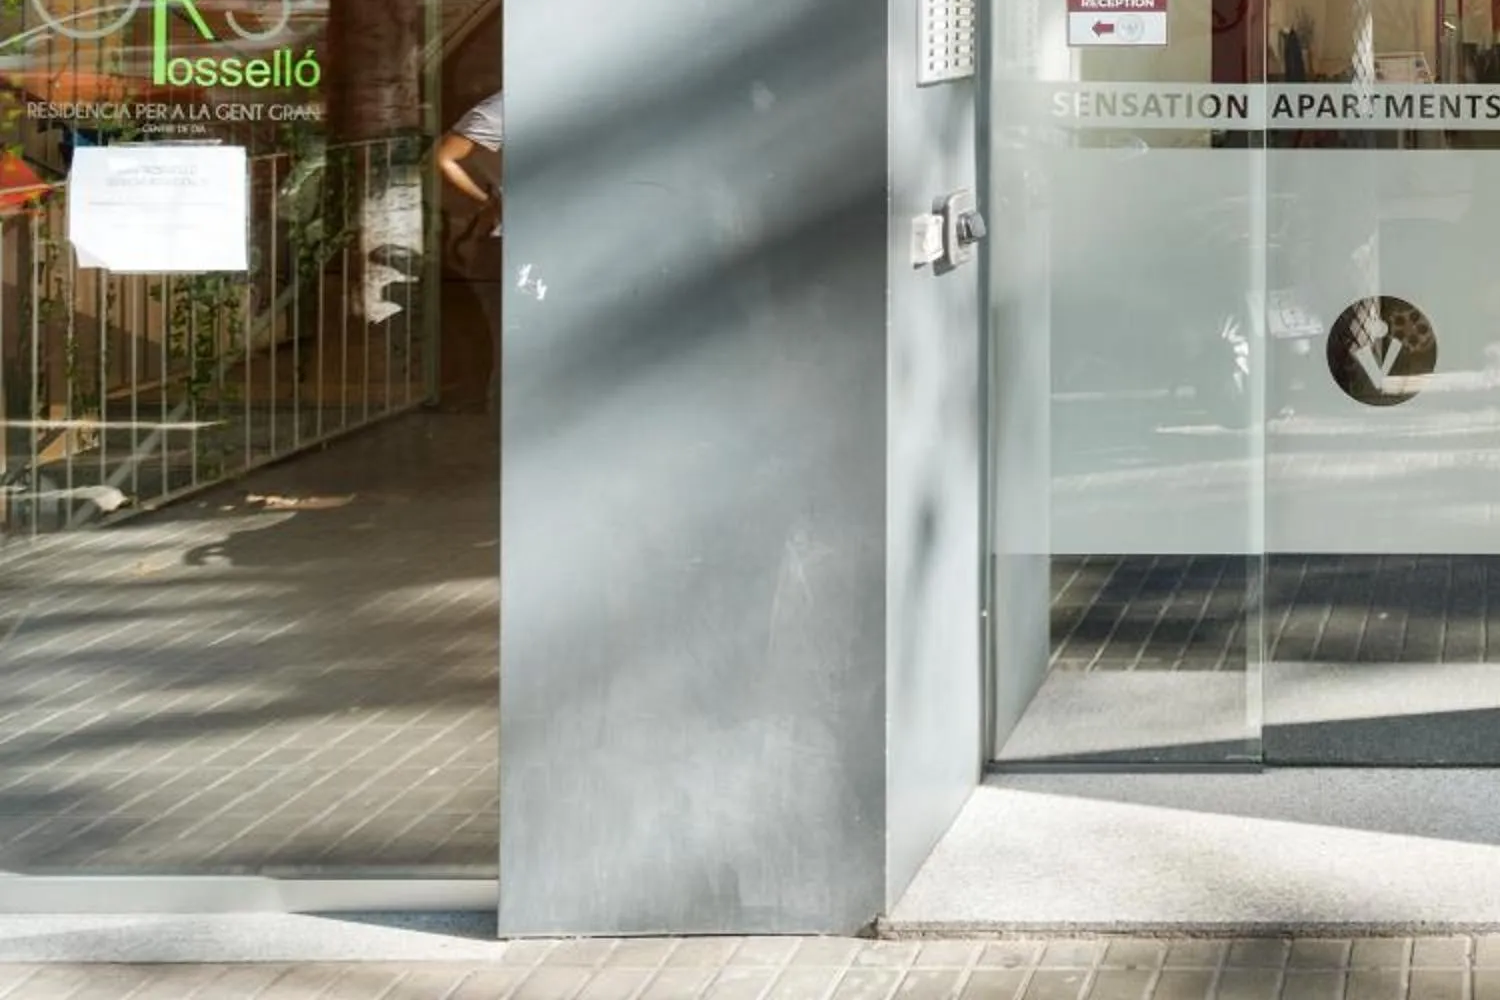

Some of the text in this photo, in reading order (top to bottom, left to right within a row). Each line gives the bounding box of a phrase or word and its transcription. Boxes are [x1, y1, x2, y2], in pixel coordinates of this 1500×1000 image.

[135, 103, 168, 120] PER
[170, 103, 186, 120] A
[189, 103, 213, 121] LA
[215, 103, 264, 121] GENT
[268, 104, 323, 121] GRAN
[1051, 92, 1249, 119] SENSATION
